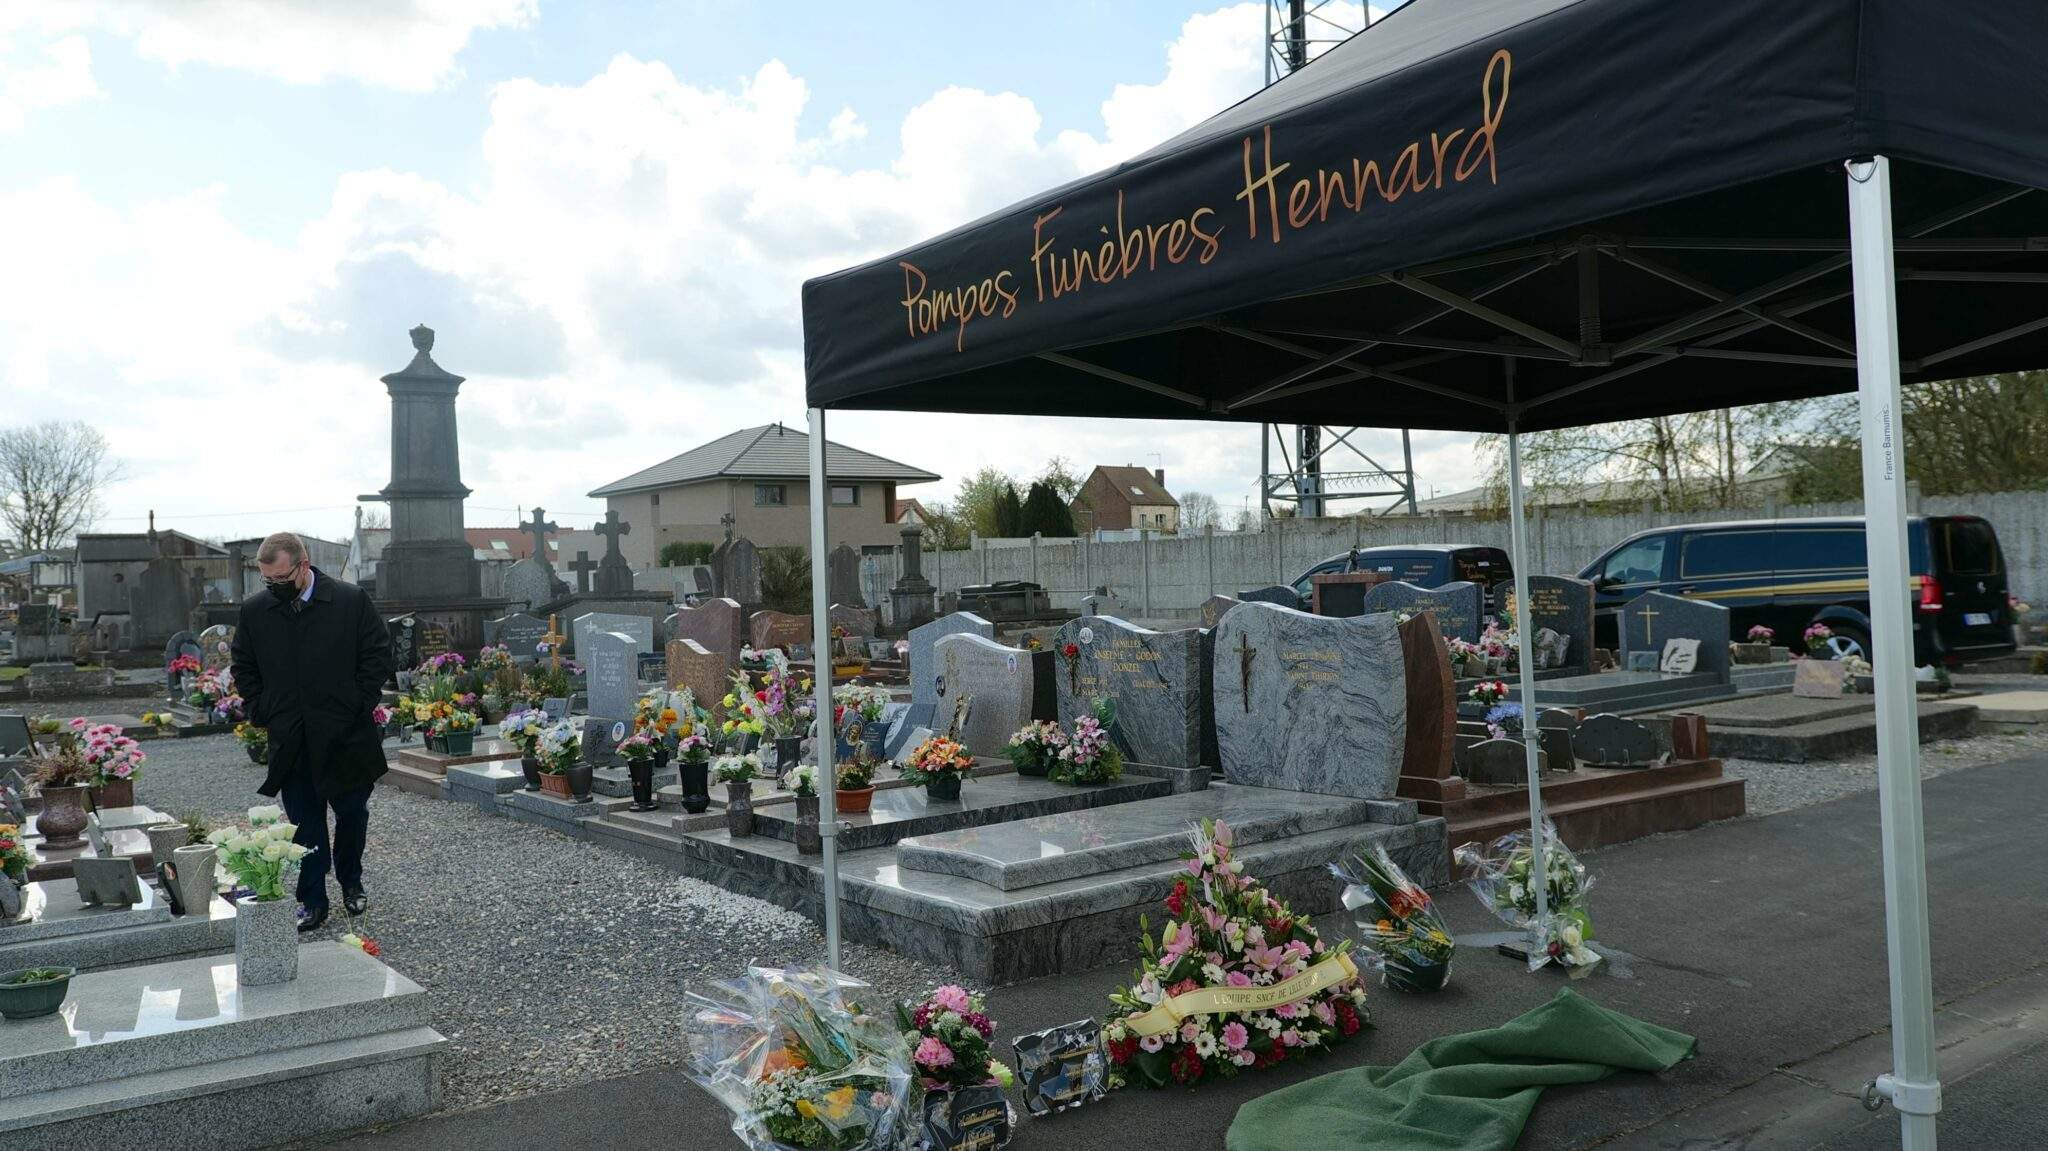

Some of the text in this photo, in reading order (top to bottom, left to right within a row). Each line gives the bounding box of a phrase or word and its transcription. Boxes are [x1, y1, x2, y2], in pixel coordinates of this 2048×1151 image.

[899, 49, 1511, 352] Pompes Funèbres Hennard
[1884, 450, 1893, 480] France
